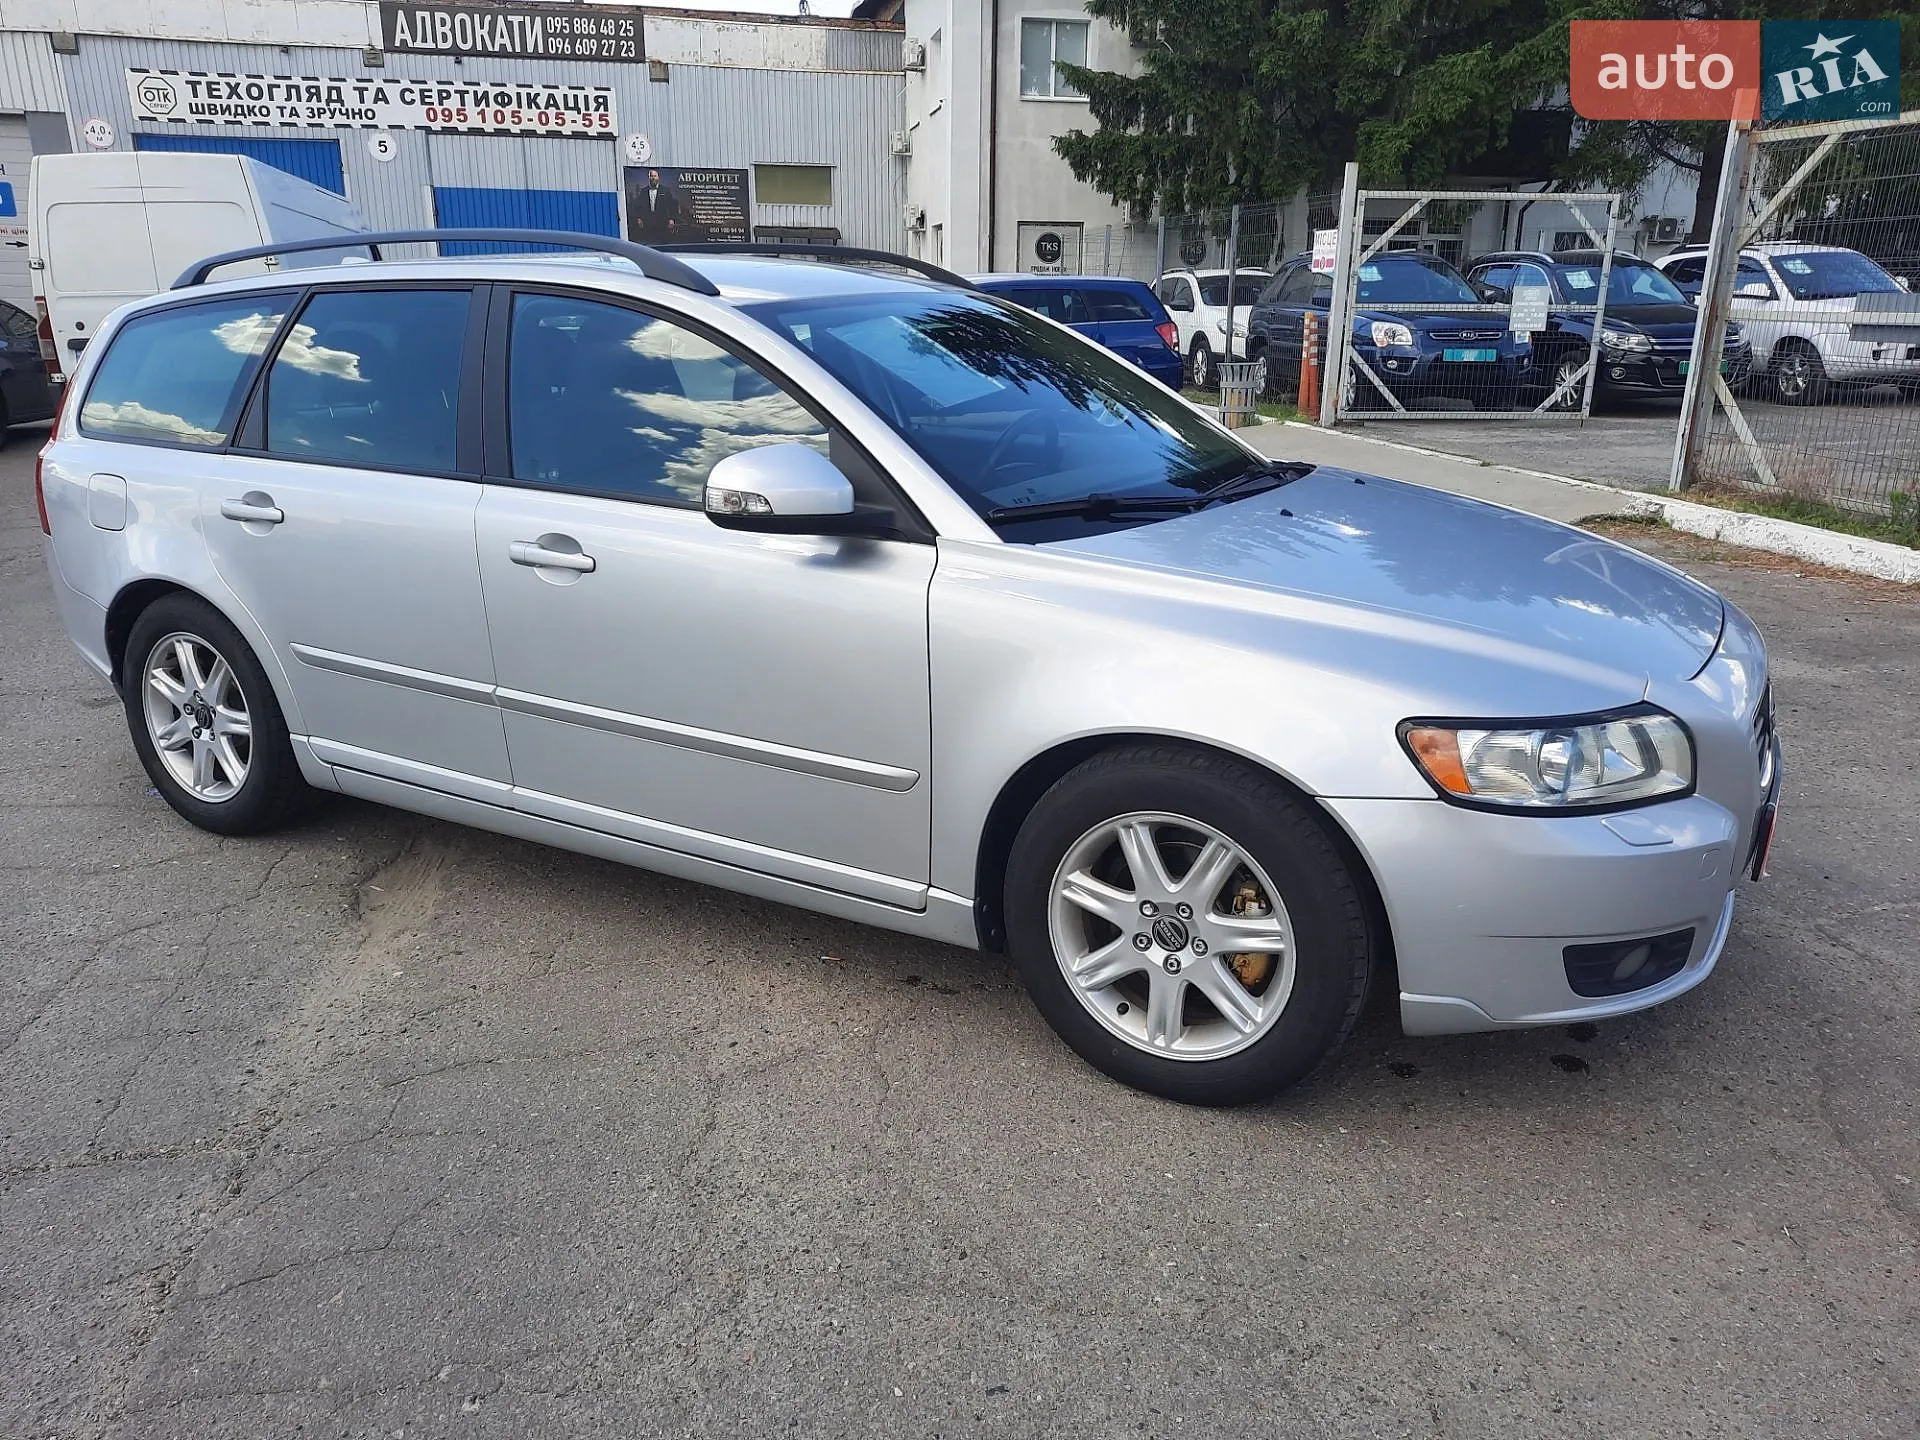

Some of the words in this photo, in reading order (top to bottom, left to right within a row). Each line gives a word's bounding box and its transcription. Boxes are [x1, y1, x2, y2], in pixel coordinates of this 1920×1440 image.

[394, 10, 544, 54] АДВОКАТИ
[547, 16, 570, 34] 095
[573, 17, 596, 36] 886
[600, 18, 615, 36] 48
[618, 19, 634, 37] 25
[548, 37, 571, 55] 096
[575, 38, 597, 56] 609
[601, 39, 616, 56] 27
[620, 40, 636, 57] 23
[185, 80, 345, 107] ТЕХОГЛЯД
[353, 86, 390, 105] ТА
[399, 87, 610, 115] СЕРТИФІКАЦІЯ
[188, 102, 271, 118] ШВИДКО
[276, 106, 301, 119] ТА
[305, 106, 376, 121] ЗРУЧНО
[425, 107, 469, 123] 095
[477, 107, 610, 129] 105-05-55
[378, 140, 388, 153] 5
[678, 173, 740, 183] АВТОРИТЕТ
[1040, 242, 1059, 251] TKS
[1158, 918, 1182, 949] VOLVO
